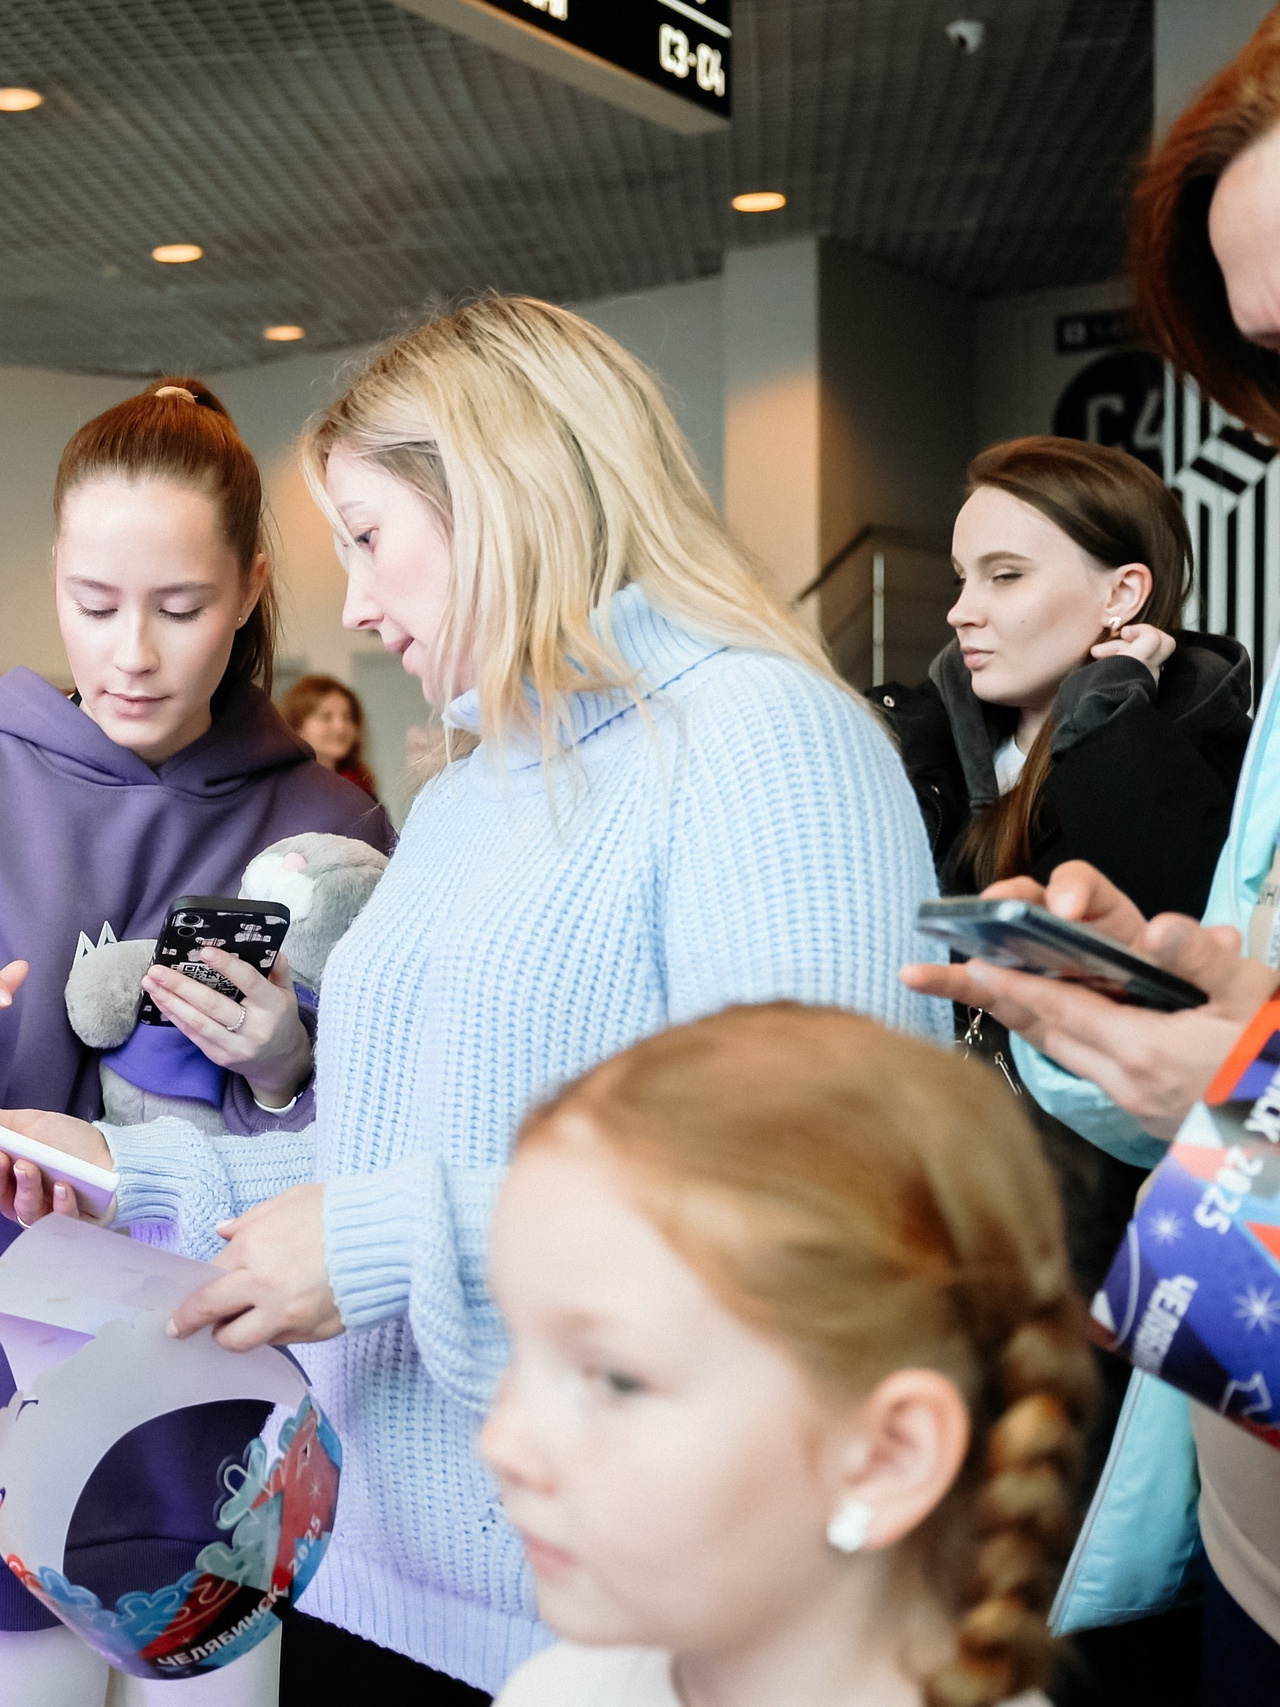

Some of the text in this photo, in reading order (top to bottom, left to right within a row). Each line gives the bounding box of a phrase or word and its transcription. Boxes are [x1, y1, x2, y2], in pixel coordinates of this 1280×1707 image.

[1193, 1146, 1264, 1235] 2025
[157, 1514, 320, 1667] ЧЕЛЯБИНСК 2025
